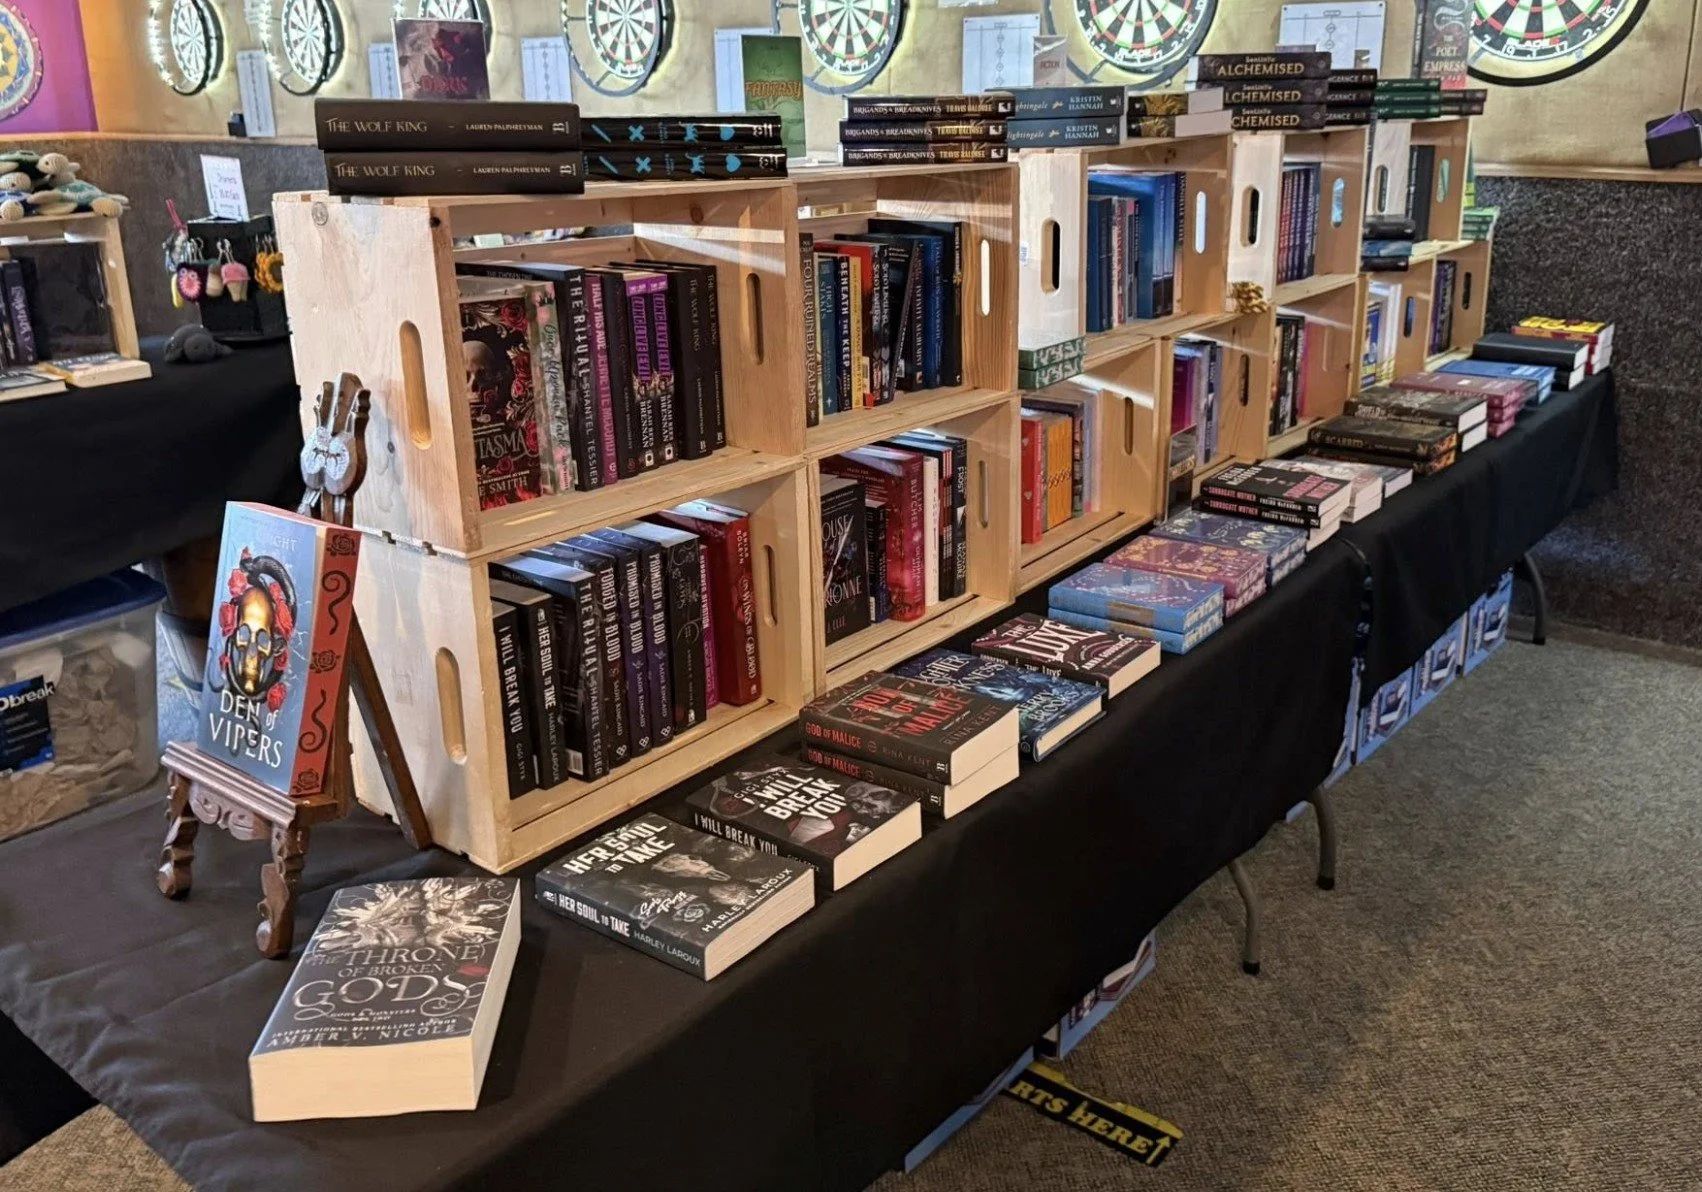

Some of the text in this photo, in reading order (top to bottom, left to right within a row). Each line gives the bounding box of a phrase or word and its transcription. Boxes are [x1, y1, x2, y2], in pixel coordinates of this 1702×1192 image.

[1423, 60, 1466, 72] EMPRESS
[1436, 46, 1458, 57] POET
[1217, 63, 1304, 76] ALCHEMISED
[853, 105, 888, 114] BRIGANDS
[894, 104, 942, 113] BREADKNIVES
[1016, 95, 1102, 111] ghtingale KRISTIN
[1069, 102, 1103, 110] HANNAH
[1225, 90, 1301, 103] LCHEMISED
[326, 117, 350, 132] THE
[355, 121, 391, 132] WOLF
[396, 121, 427, 132] KING
[845, 129, 879, 137] BRIGANDS
[885, 128, 932, 136] BREADKNIVES
[1231, 115, 1300, 127] CHEMISED
[334, 162, 357, 177] THE
[364, 166, 400, 176] WOLF
[404, 165, 435, 176] KING
[848, 152, 883, 160] BRIGANDS
[569, 275, 583, 309] THE
[591, 283, 603, 309] HALF
[840, 262, 851, 368] BENEATH THE KEEP
[803, 259, 817, 404] FOUR RUINED REALMS
[478, 428, 530, 458] TASMA
[584, 383, 598, 486] SHANTEL TESSIER
[489, 476, 528, 494] SMITH
[821, 514, 850, 542] OUSE
[626, 561, 644, 655] PROMISED IN BLOOD
[649, 552, 667, 646] PROMISED IN BLOOD
[600, 566, 621, 663] FORGED IN BLOOD
[538, 626, 549, 646] HER
[579, 582, 598, 677] THE RITUAL
[998, 619, 1108, 664] LUXE
[539, 646, 553, 676] SOUL
[954, 660, 1005, 690] KNESS
[499, 626, 523, 734] I WILL BREAK YOU
[219, 689, 278, 731] DEN of
[544, 684, 556, 710] TAKE
[892, 700, 919, 714] OF
[1029, 690, 1081, 722] BROOKS
[587, 678, 604, 776] SHANTEL TESSIER
[902, 692, 969, 737] MALICE
[208, 713, 283, 769] VIPERS
[806, 723, 822, 737] GOD
[831, 729, 862, 749] MALICE
[808, 750, 823, 764] GOD
[832, 758, 862, 777] MALICE
[753, 774, 815, 803] WILL
[764, 777, 842, 821] BREAK
[801, 793, 849, 820] YOU
[563, 822, 668, 875] HER SOUL
[695, 813, 778, 857] I WILL BREAK YOU
[611, 836, 675, 864] TAKE
[701, 868, 794, 933] HARLEY LAROUX
[559, 893, 631, 938] HER SOUL TO TAKE
[345, 946, 479, 966] THRONE
[633, 931, 701, 967] HARLEY LAROUX
[338, 963, 446, 978] OF BROKEN
[293, 974, 484, 1019] GODS
[266, 1024, 457, 1048] AMBER V. NICOLE
[271, 1017, 458, 1039] INTERNATIONAL BESTSELLING AUTHOR
[1009, 1079, 1154, 1155] RTS HERE
